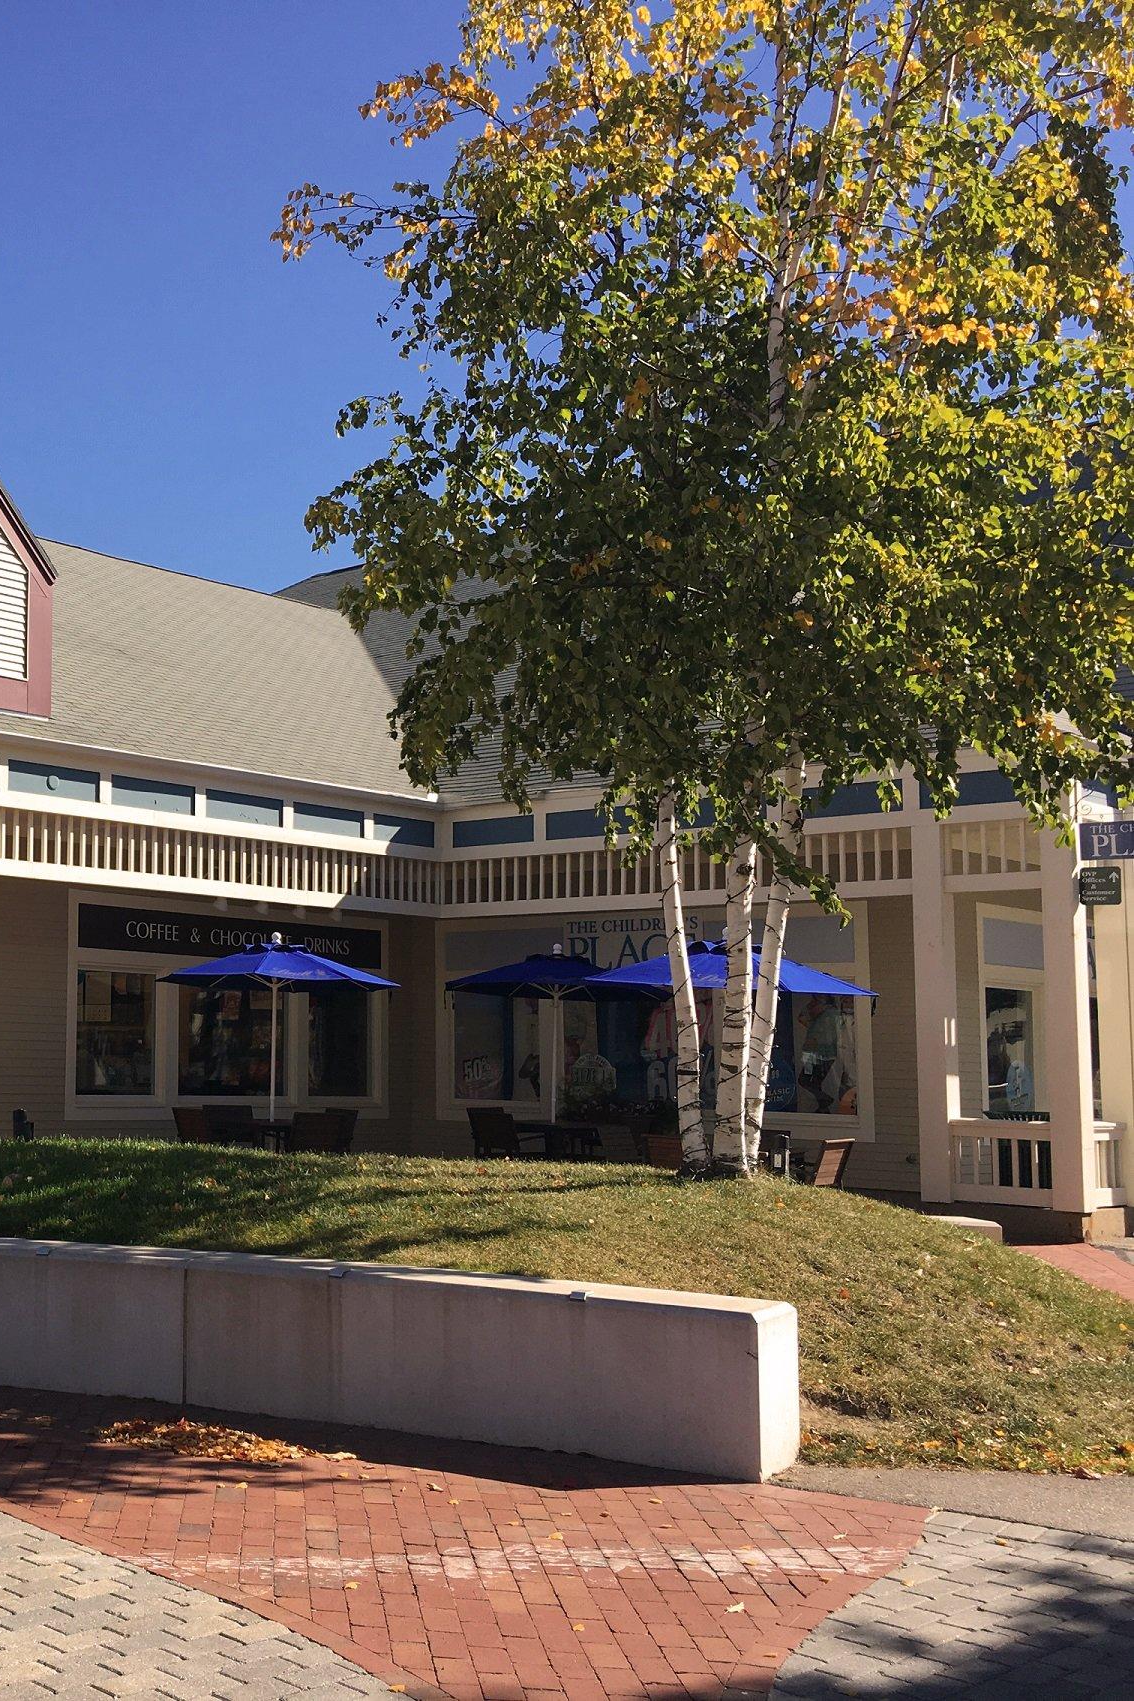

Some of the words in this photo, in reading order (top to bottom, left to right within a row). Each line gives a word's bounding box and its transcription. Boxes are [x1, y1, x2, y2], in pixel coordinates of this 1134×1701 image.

[1090, 825, 1114, 834] THE
[1091, 833, 1134, 857] PL
[567, 921, 596, 934] THE
[126, 921, 179, 942] COFFEE
[190, 927, 201, 943] &
[304, 937, 350, 955] DRINKS
